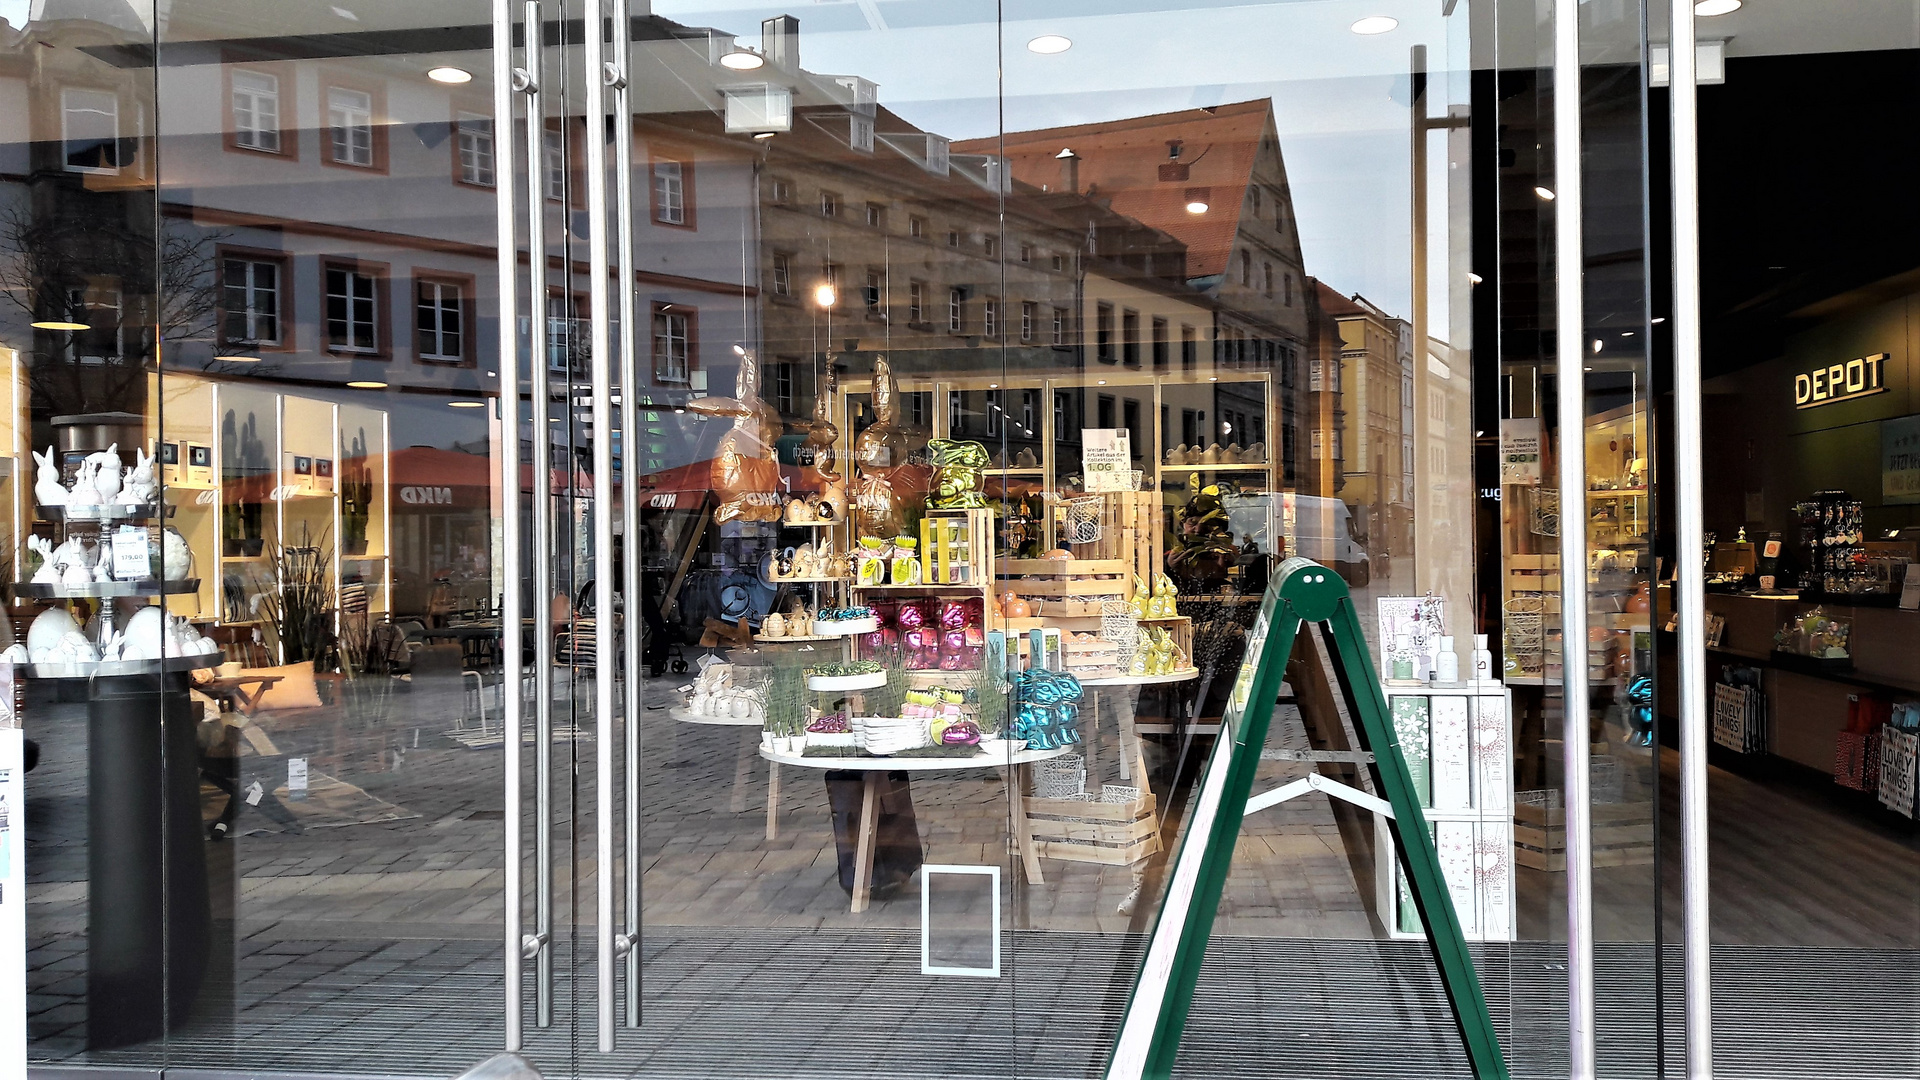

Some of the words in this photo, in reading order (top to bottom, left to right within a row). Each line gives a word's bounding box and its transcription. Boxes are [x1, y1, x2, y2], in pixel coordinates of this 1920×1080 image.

[1795, 352, 1883, 405] DEPOT
[1087, 463, 1095, 471] 1.
[1097, 463, 1112, 471] OG
[1716, 700, 1741, 719] LOVELY
[1715, 713, 1740, 733] THINGS
[1882, 746, 1912, 774] LOVELY
[1881, 763, 1908, 792] THINGS
